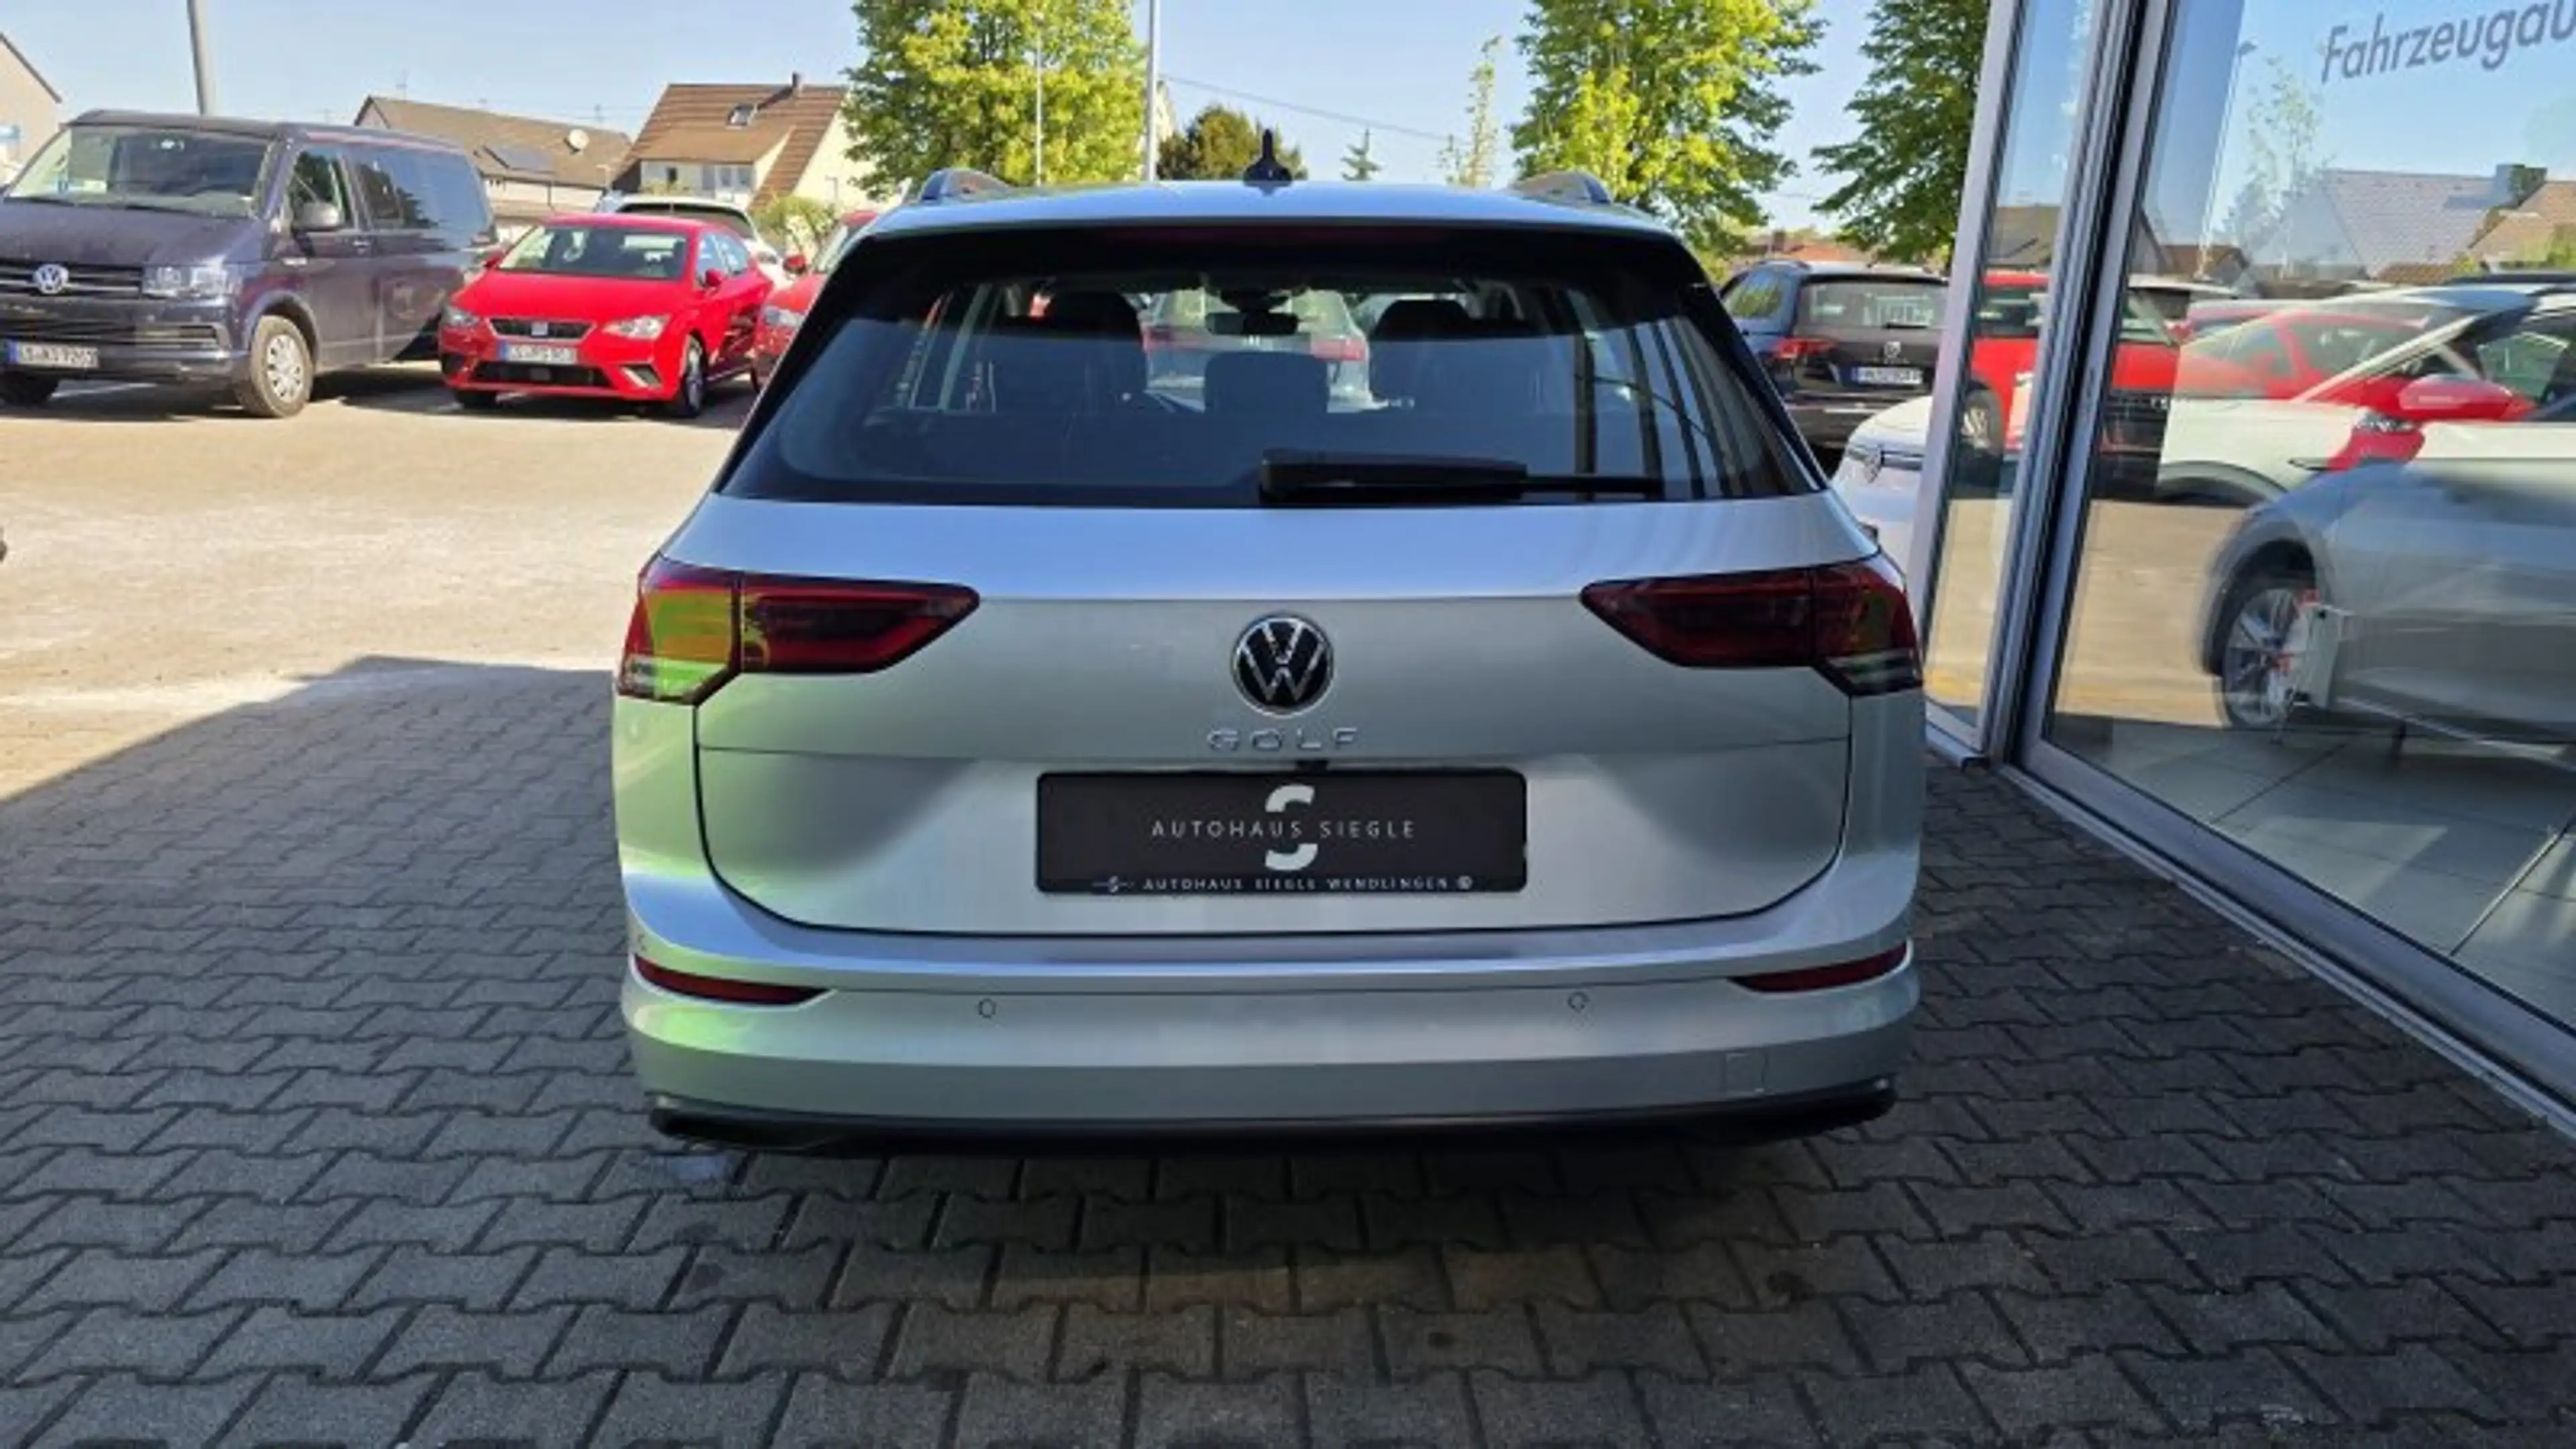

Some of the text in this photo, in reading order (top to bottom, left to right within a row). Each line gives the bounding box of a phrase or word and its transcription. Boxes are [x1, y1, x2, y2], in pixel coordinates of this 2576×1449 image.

[1206, 727, 1359, 752] GOLF
[1151, 820, 1415, 839] AUTOHAUS SIEGLE
[1142, 875, 1449, 891] AUTOHAUS SIEGLE WENDLINGEN
